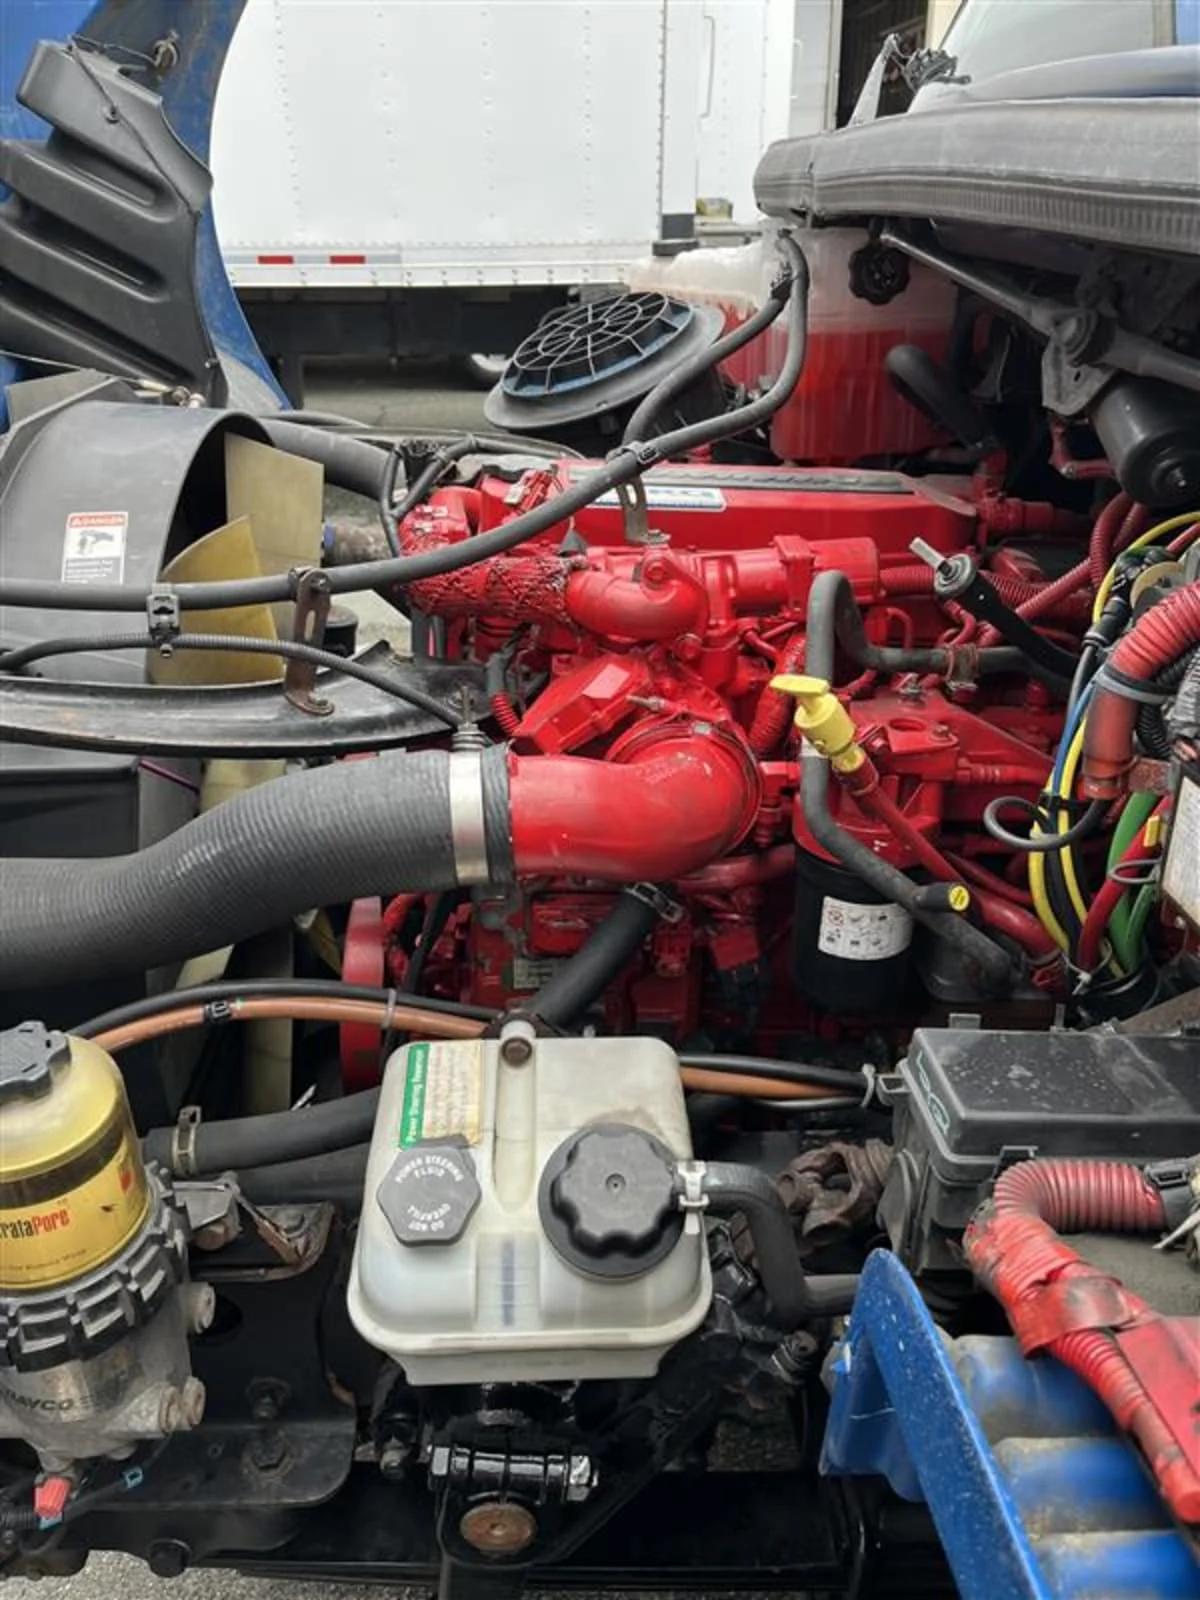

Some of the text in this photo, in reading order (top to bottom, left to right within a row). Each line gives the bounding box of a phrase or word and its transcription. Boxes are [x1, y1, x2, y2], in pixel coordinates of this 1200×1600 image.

[395, 1154, 465, 1184] POWER STEERING
[413, 1165, 446, 1179] FLUID
[0, 1208, 70, 1239] rataPore
[407, 1220, 445, 1232] DO NOT
